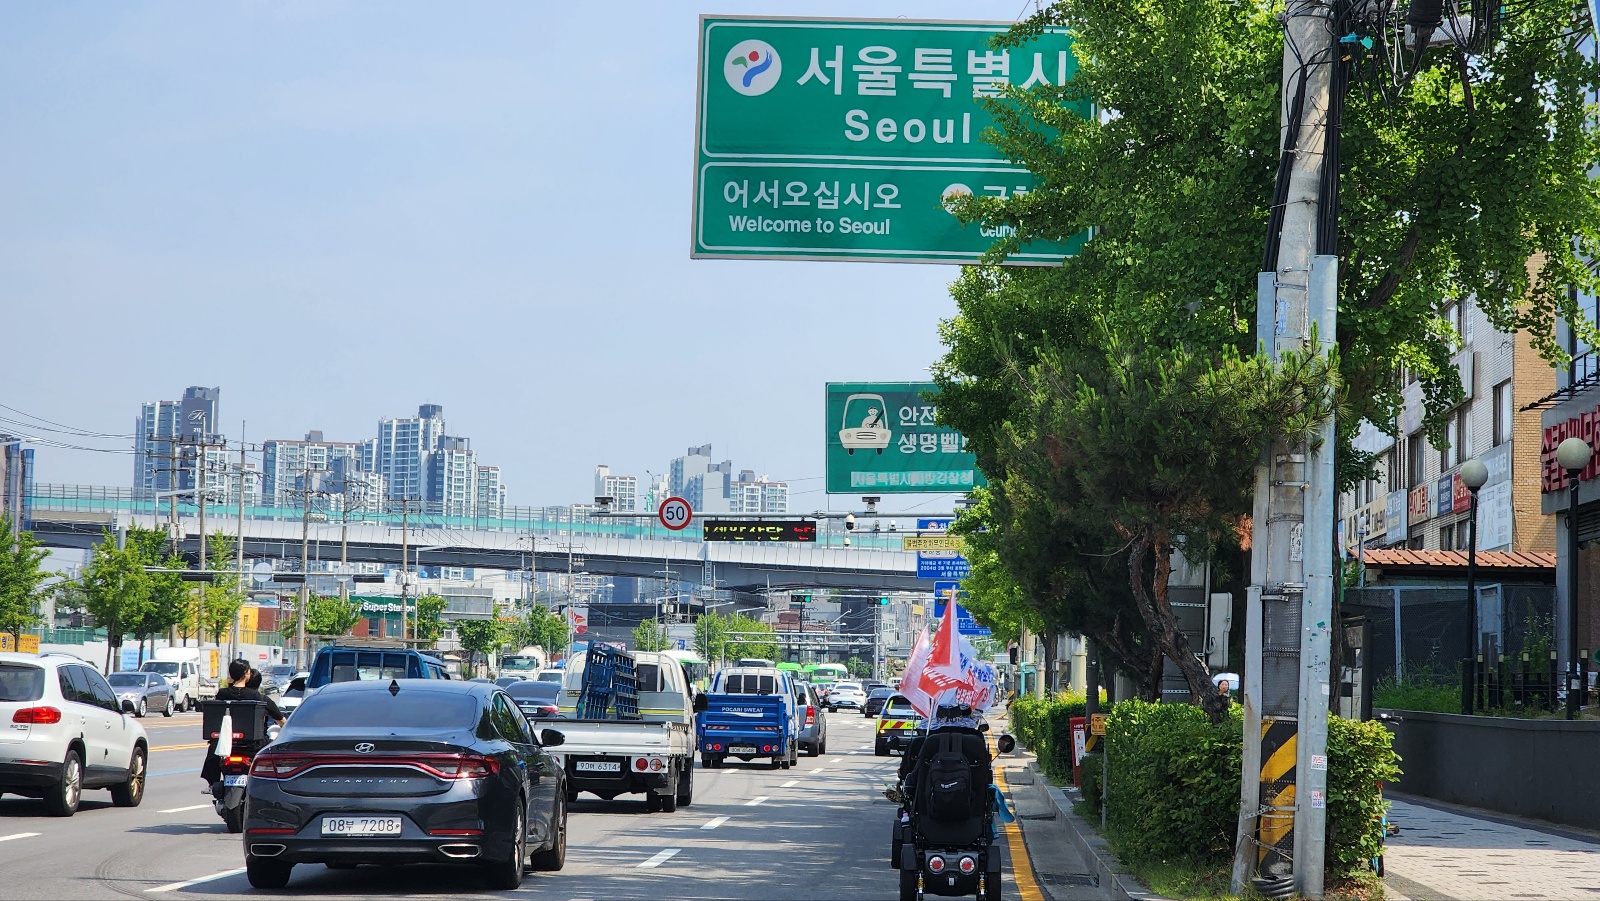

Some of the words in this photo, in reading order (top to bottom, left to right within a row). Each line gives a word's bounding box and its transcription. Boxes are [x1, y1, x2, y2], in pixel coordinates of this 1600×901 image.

[797, 45, 1067, 98] 서울특별시
[844, 109, 971, 144] Seoul
[723, 179, 902, 211] 어서오십시오
[728, 215, 812, 233] Welcome
[816, 217, 835, 233] to
[839, 217, 890, 235] Seoul
[666, 506, 685, 520] 50
[597, 763, 617, 771] 6314
[329, 819, 354, 832] 08부
[360, 819, 394, 832] 7208
